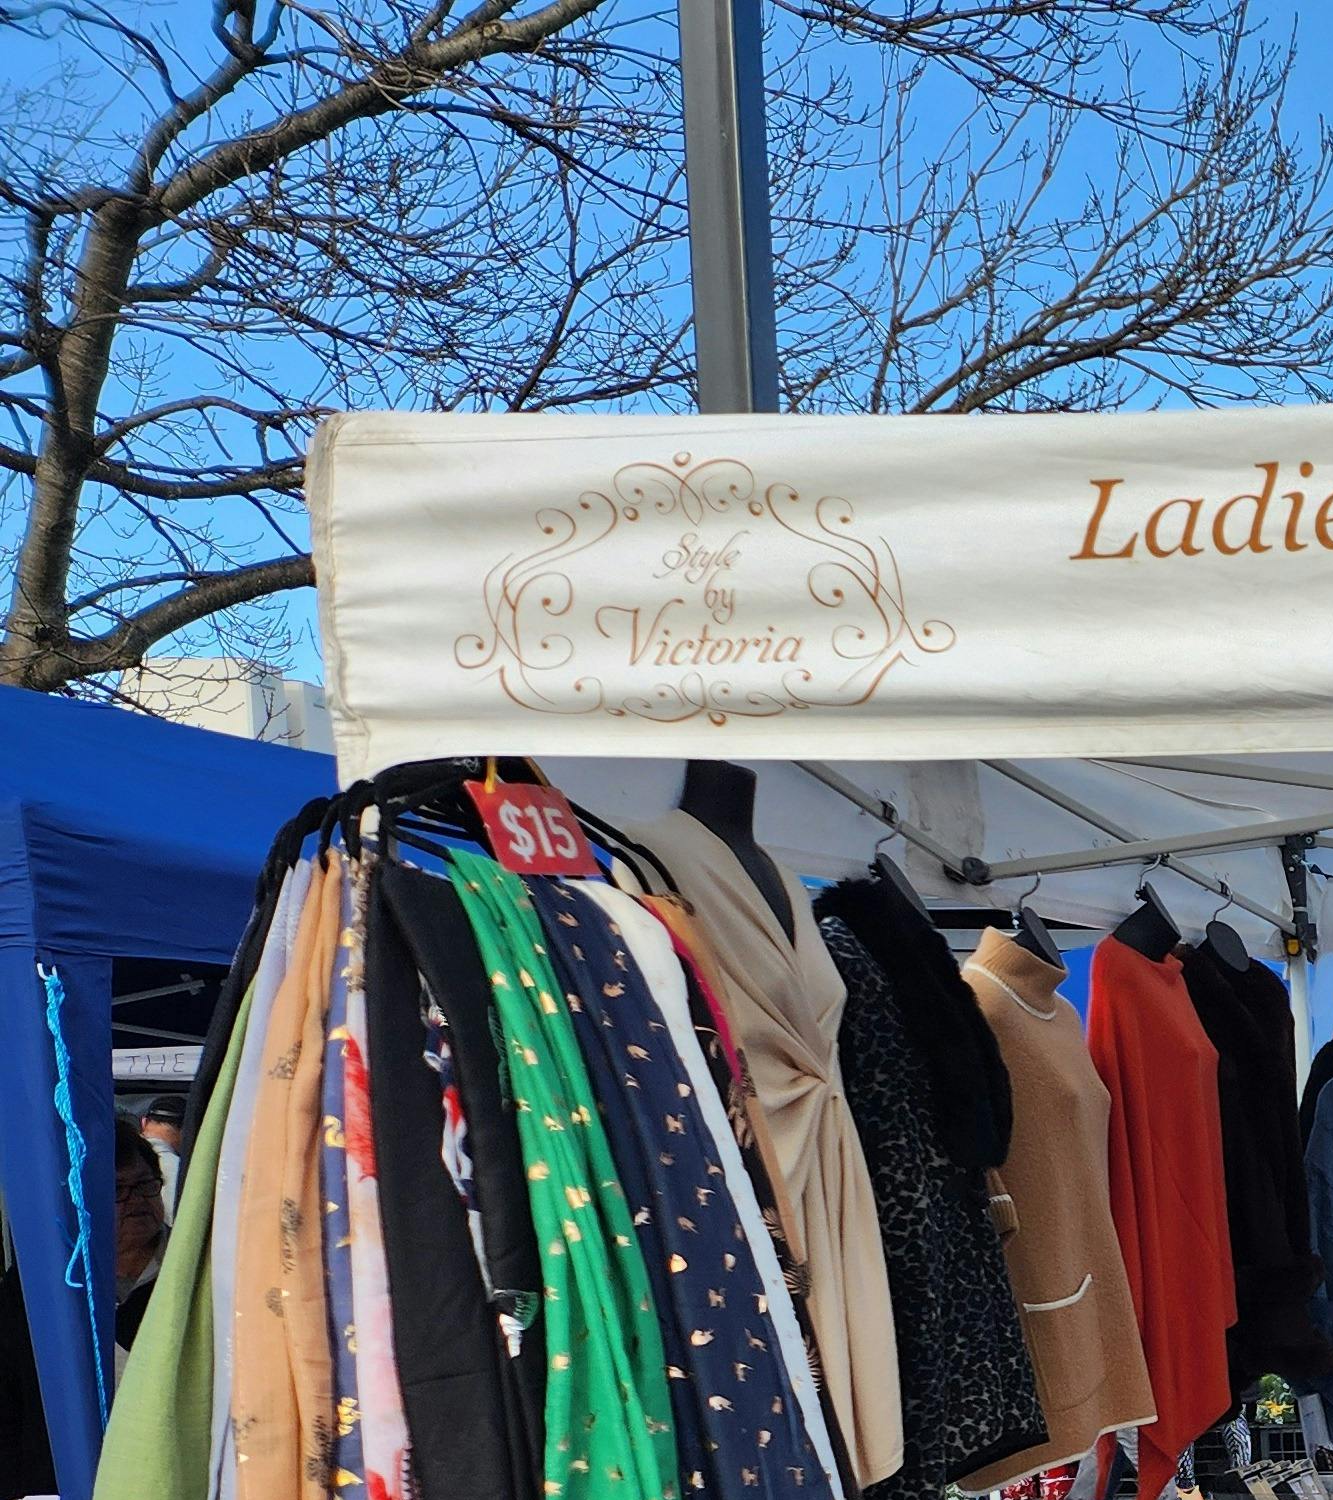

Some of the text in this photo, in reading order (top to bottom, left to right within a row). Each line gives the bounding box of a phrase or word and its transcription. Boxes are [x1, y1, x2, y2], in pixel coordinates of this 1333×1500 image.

[652, 530, 744, 586] Style
[703, 580, 736, 622] by
[594, 598, 802, 670] Victoria
[498, 799, 580, 864] $15
[124, 1053, 185, 1073] THE
